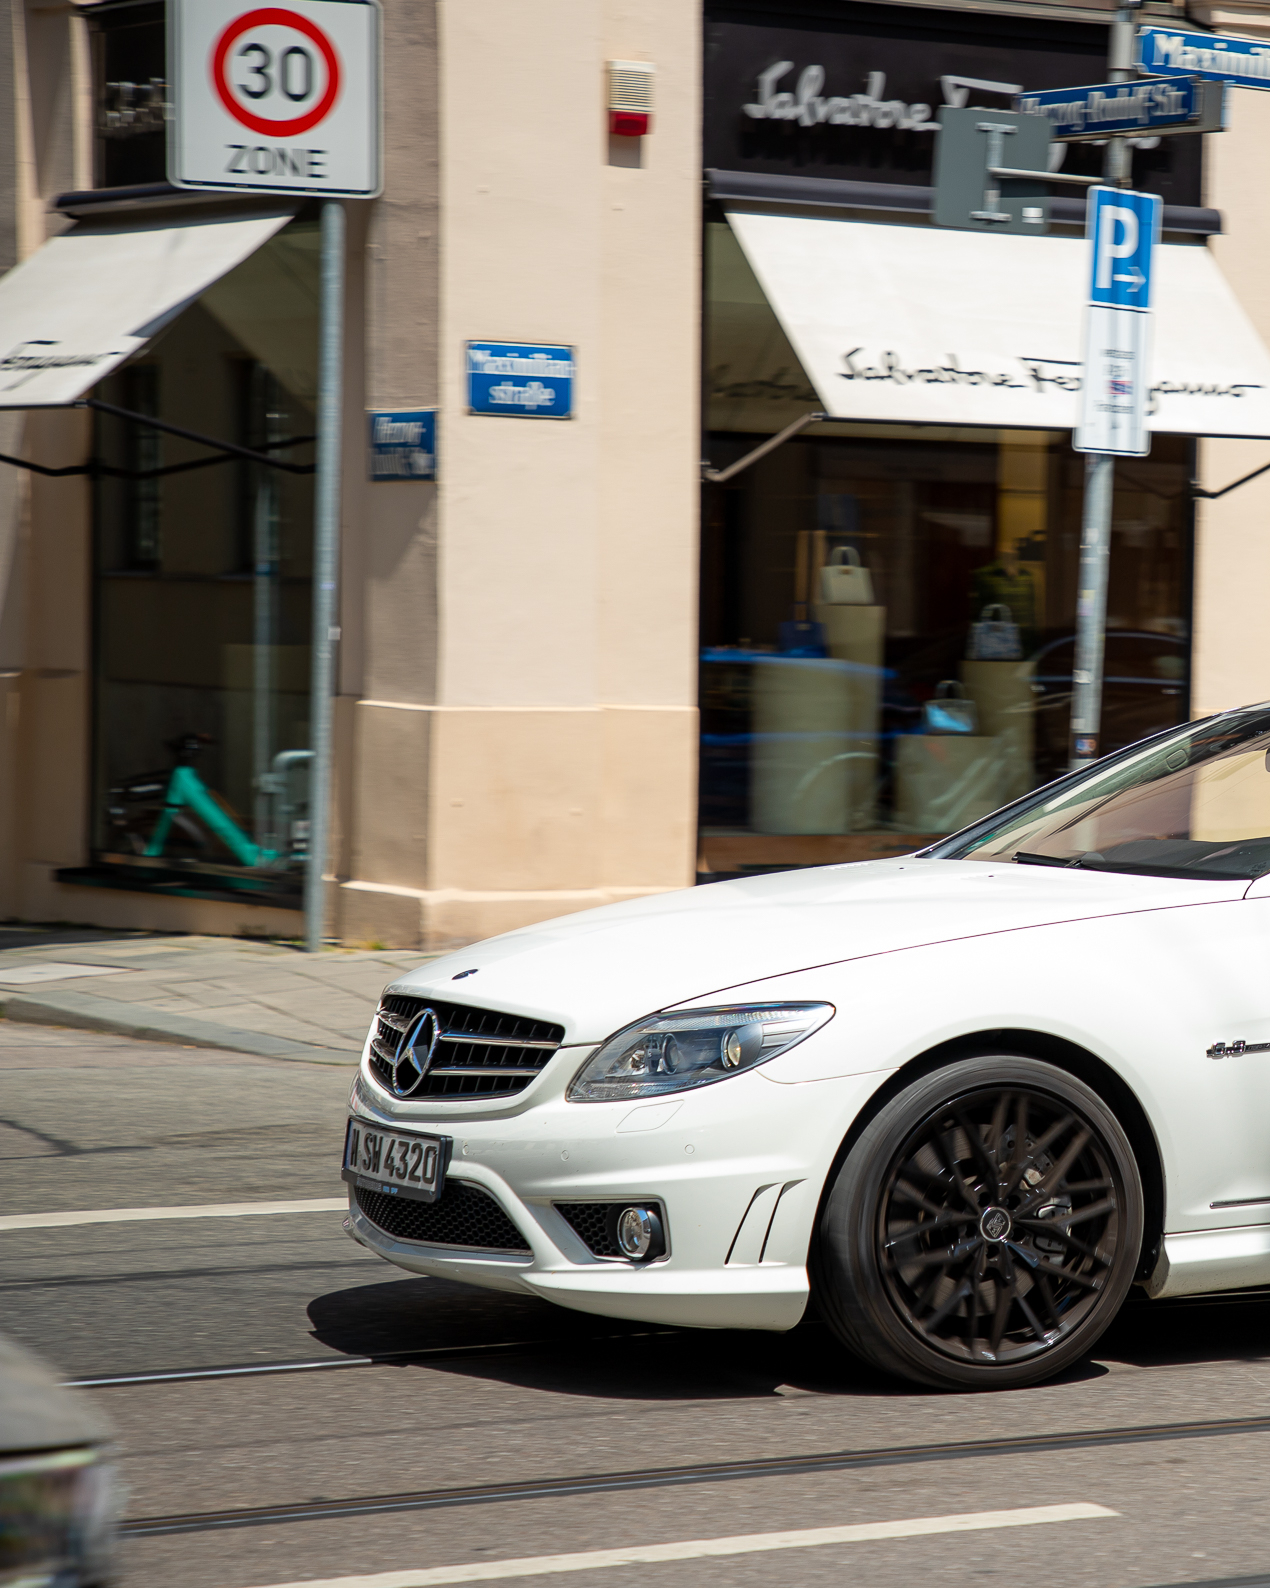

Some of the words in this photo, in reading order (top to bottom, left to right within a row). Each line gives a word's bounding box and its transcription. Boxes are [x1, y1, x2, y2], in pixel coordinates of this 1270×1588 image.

[234, 42, 314, 102] 30
[741, 60, 943, 131] Salvatore
[225, 144, 328, 178] ZONE
[1095, 204, 1139, 288] P
[836, 346, 1030, 387] Salvatore
[384, 1138, 437, 1185] 4320
